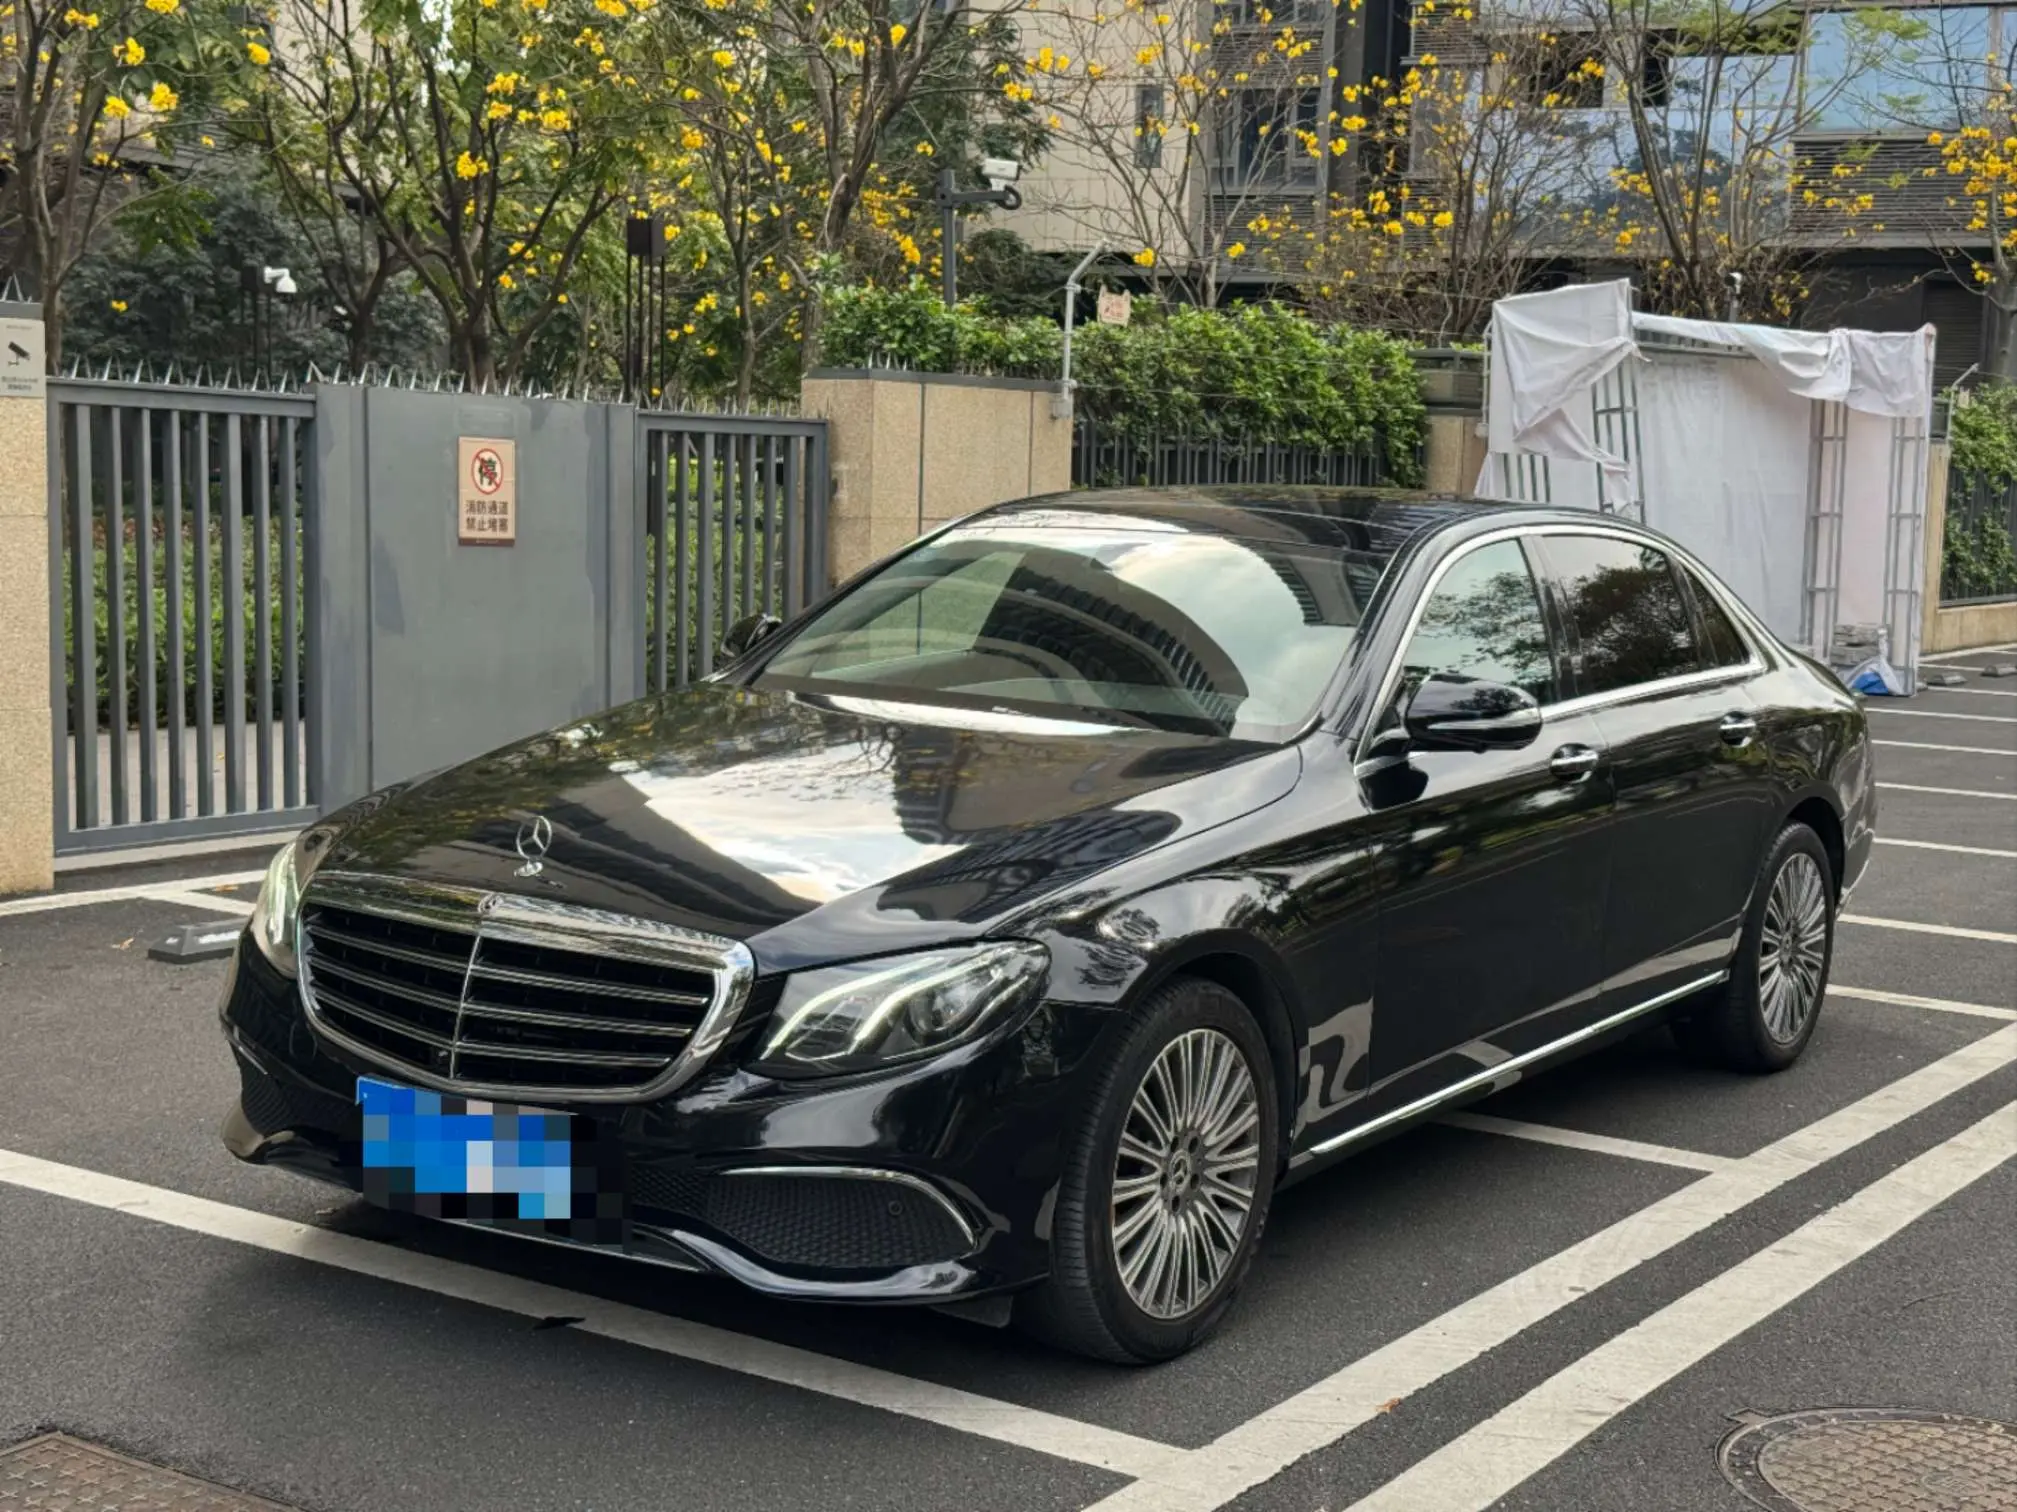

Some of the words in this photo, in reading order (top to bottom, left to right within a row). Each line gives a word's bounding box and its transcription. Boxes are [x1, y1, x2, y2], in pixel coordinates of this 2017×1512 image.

[478, 457, 498, 486] 停
[465, 500, 508, 515] 消防通道
